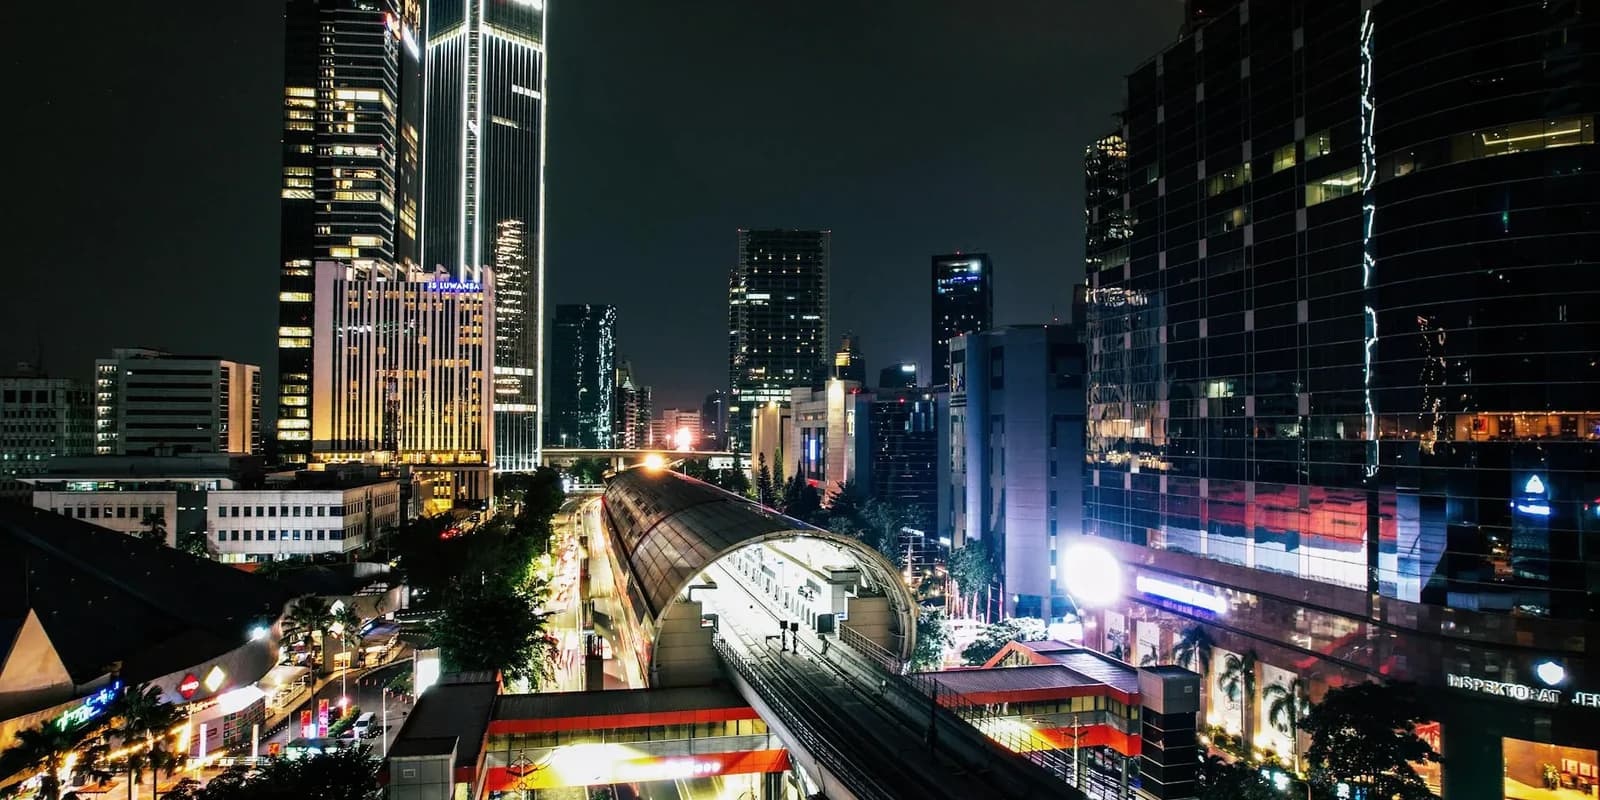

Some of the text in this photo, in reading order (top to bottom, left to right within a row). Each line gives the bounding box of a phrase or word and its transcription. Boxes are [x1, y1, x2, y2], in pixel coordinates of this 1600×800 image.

[428, 282, 480, 290] JS LUWANSA
[1447, 673, 1562, 703] INSPEKTORAT
